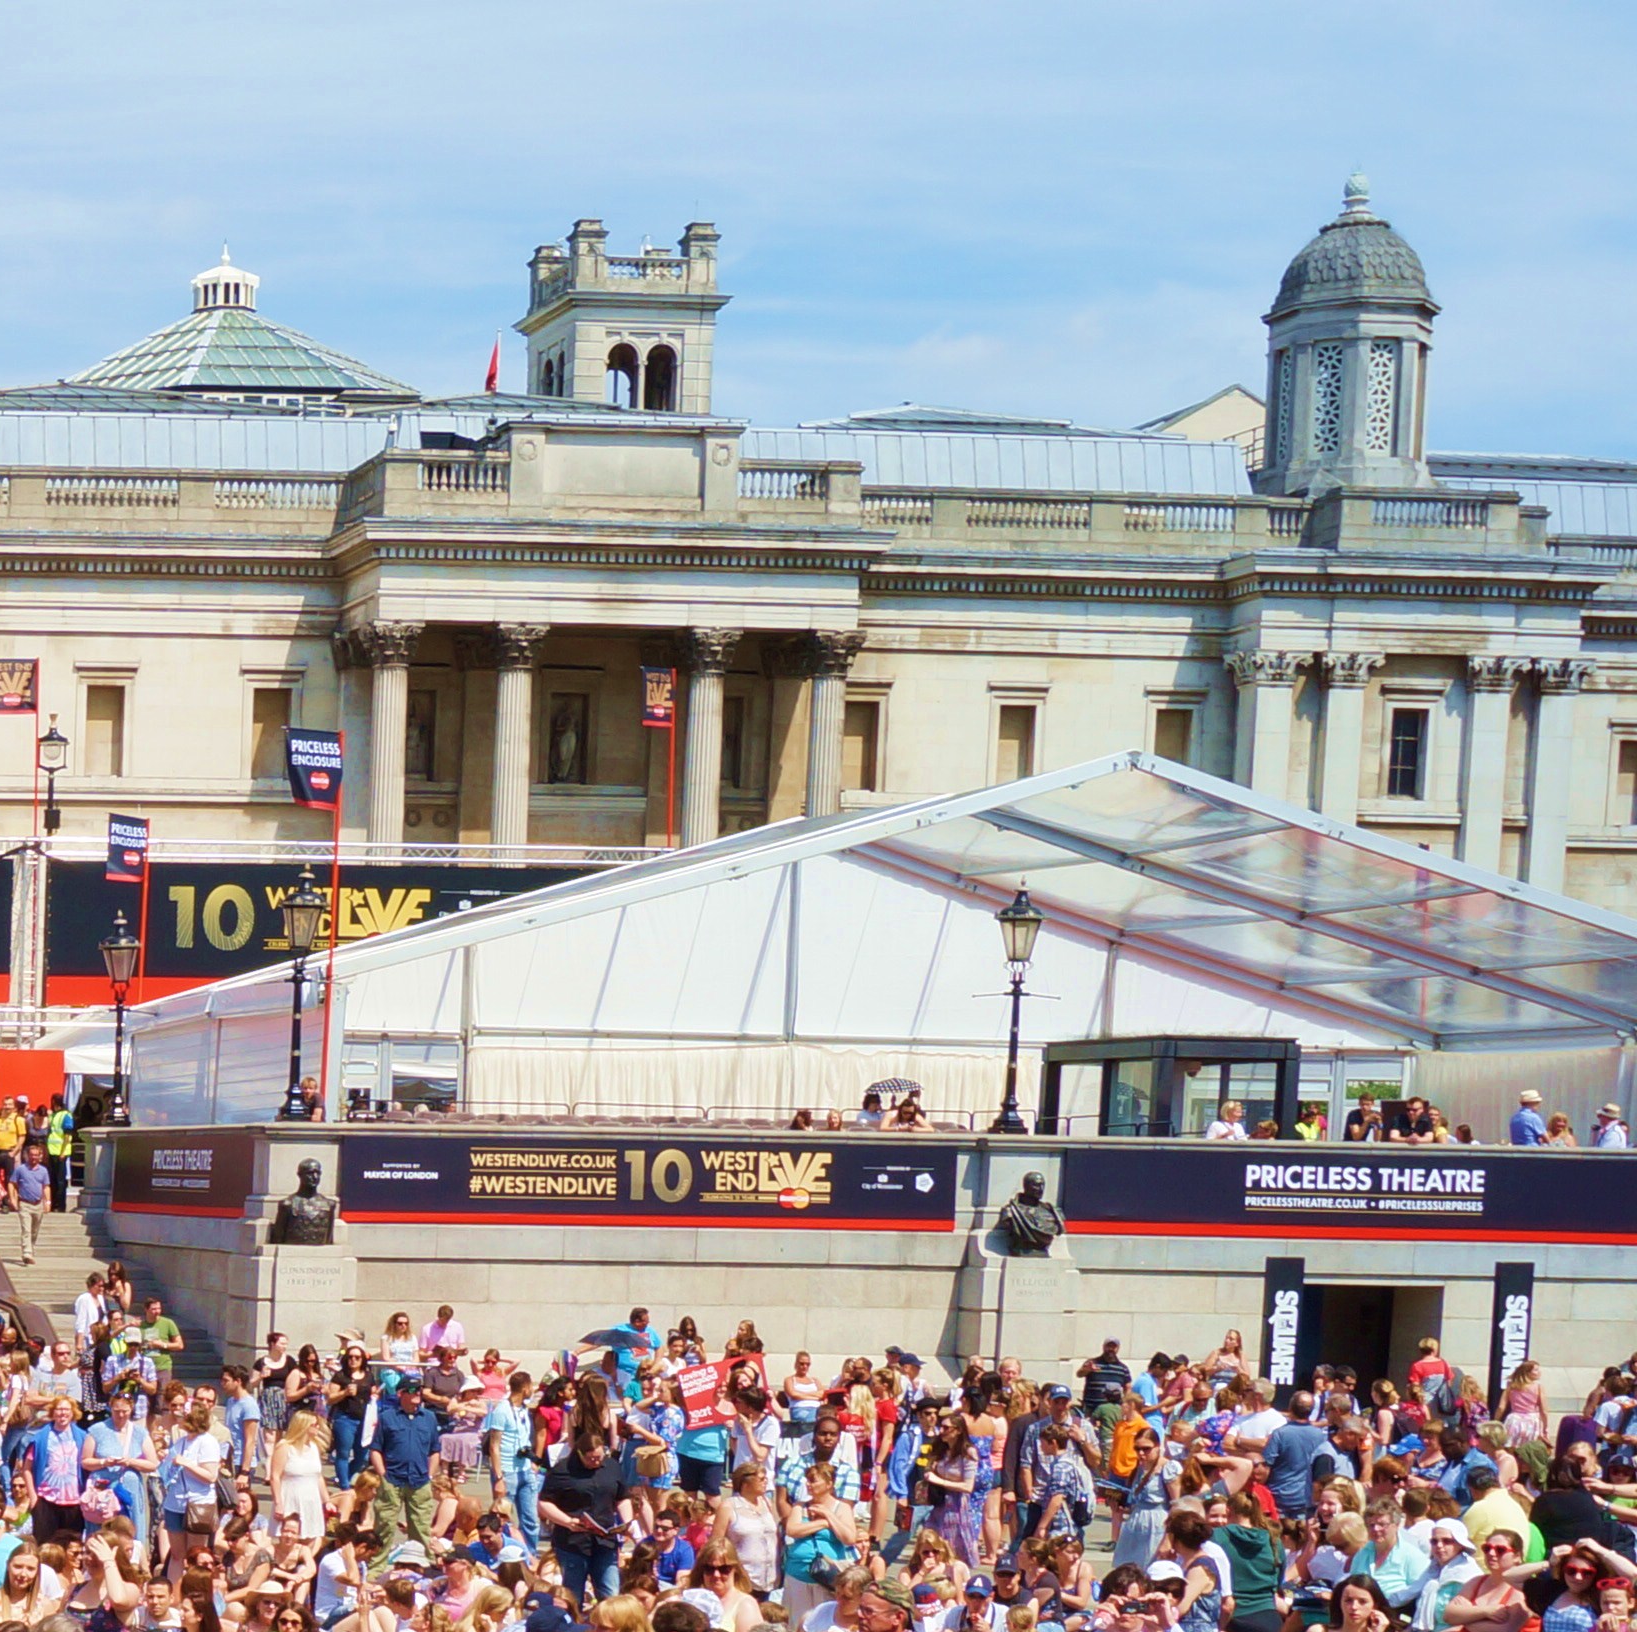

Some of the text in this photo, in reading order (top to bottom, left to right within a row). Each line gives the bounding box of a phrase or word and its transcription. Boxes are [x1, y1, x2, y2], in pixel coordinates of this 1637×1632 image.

[646, 681, 673, 706] LIVE
[291, 739, 341, 756] PRICELESS
[292, 754, 342, 768] ENCLOSURE
[169, 884, 256, 951] 10
[470, 1153, 617, 1168] WESTENDLIVE.CO.UK
[364, 1171, 438, 1179] MAYOR OF LONDON
[625, 1148, 832, 1203] 10 WEST LIVE
[715, 1172, 757, 1192] END
[1245, 1164, 1485, 1193] PRICELESS THEATRE
[469, 1176, 617, 1195] #WESTENDLIVE
[1245, 1196, 1484, 1212] PRICELESSTHEATRE.CO.UK #PRICELESSSURPRISES
[1268, 1290, 1299, 1385] SQUARE
